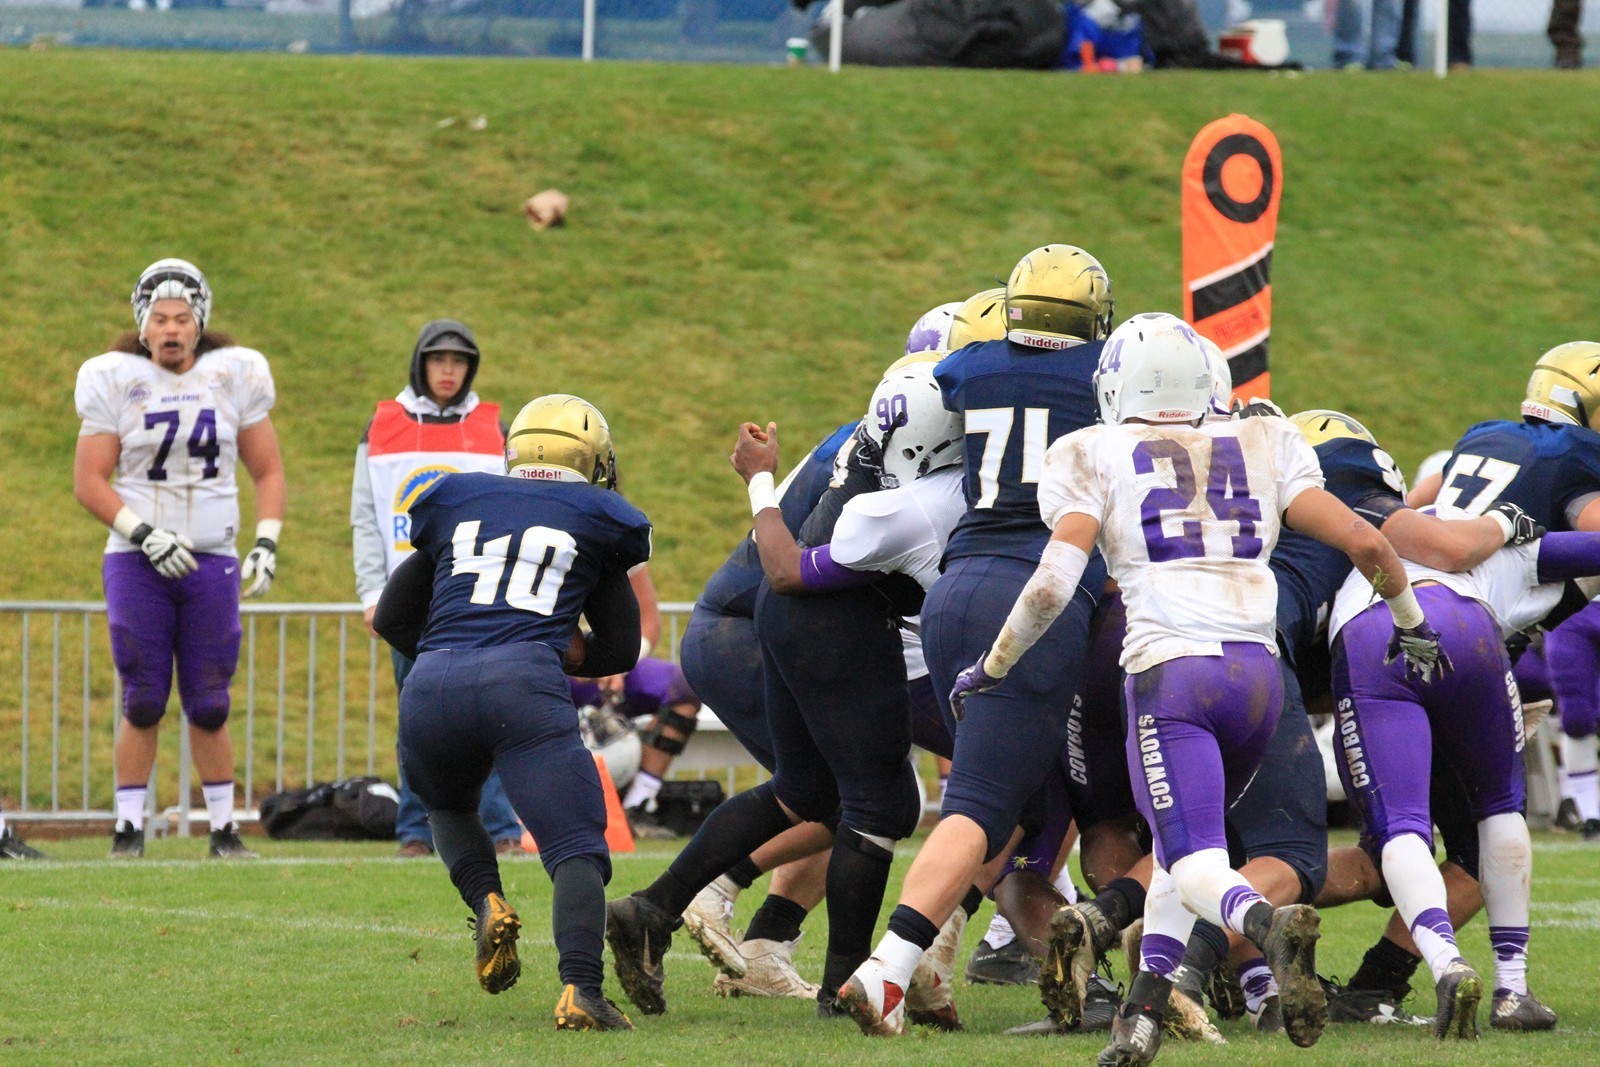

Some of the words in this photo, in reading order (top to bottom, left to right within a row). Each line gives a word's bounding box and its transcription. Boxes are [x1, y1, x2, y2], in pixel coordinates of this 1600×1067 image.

[1024, 336, 1068, 350] Riddell
[1100, 338, 1125, 376] 24
[876, 393, 909, 432] 90
[1158, 410, 1192, 419] Riddell
[144, 408, 220, 481] 74
[520, 469, 562, 479] Riddell
[1132, 436, 1264, 563] 24
[451, 520, 579, 616] 40
[1138, 714, 1174, 810] COWBOYS
[1337, 697, 1370, 789] COWBOYS
[1130, 1014, 1154, 1053] NIKE
